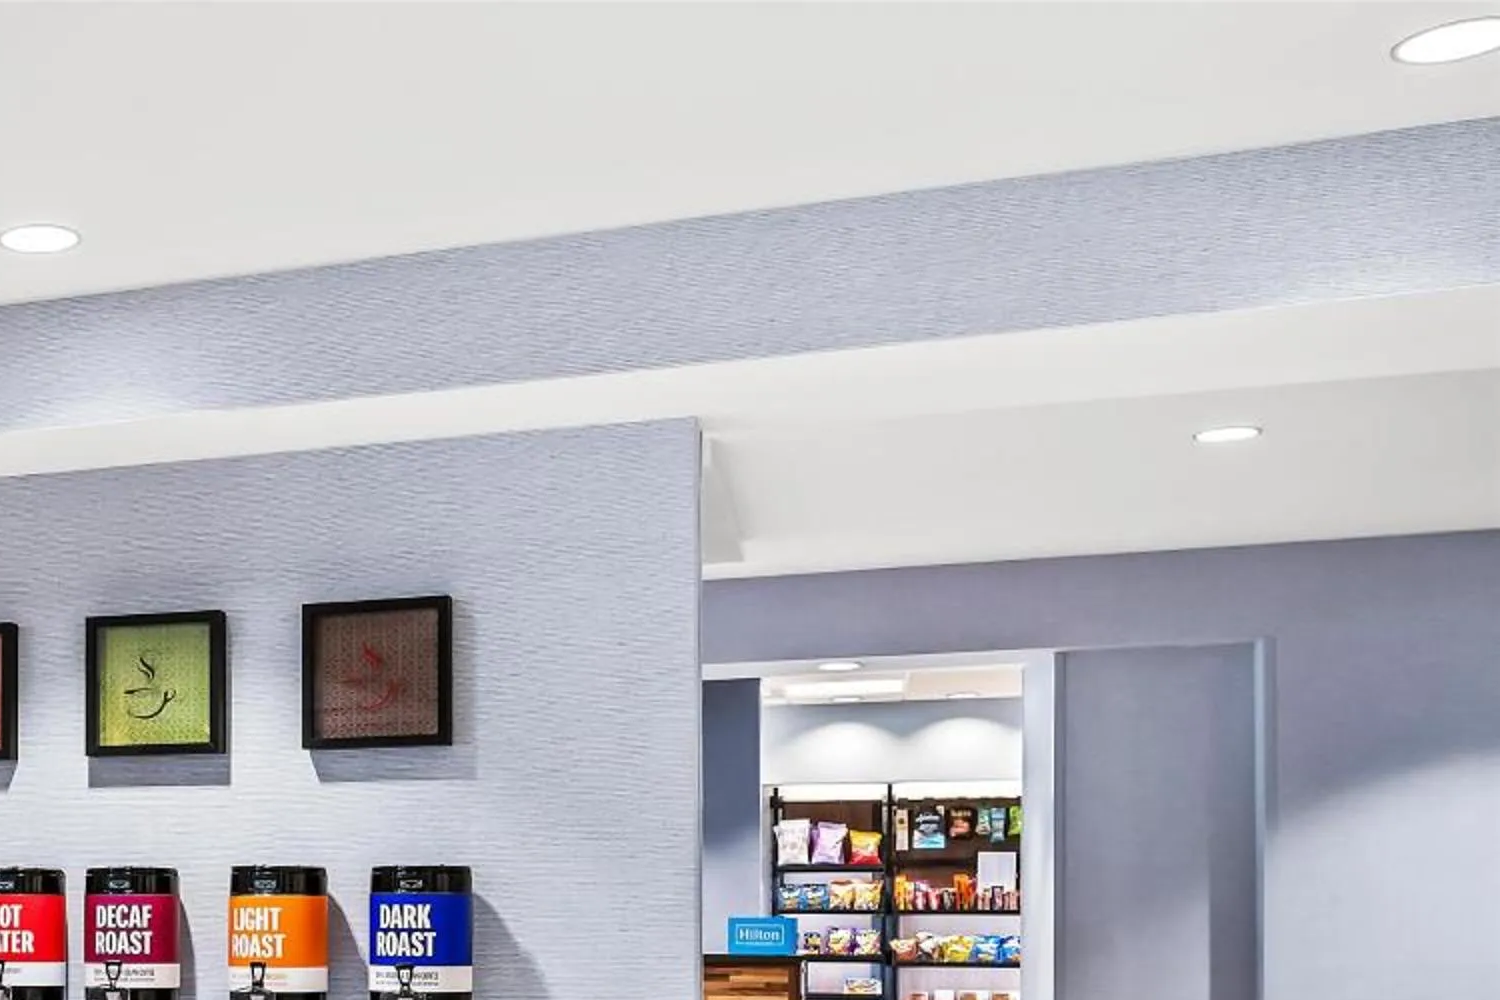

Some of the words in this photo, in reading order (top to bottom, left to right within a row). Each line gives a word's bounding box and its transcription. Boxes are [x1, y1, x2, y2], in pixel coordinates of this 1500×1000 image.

[96, 904, 153, 929] DECAF
[233, 906, 282, 931] LIGHT
[379, 903, 431, 929] DARK
[95, 931, 153, 955] ROAST
[232, 933, 286, 958] ROAST
[376, 932, 436, 957] ROAST
[739, 927, 780, 941] Hilton
